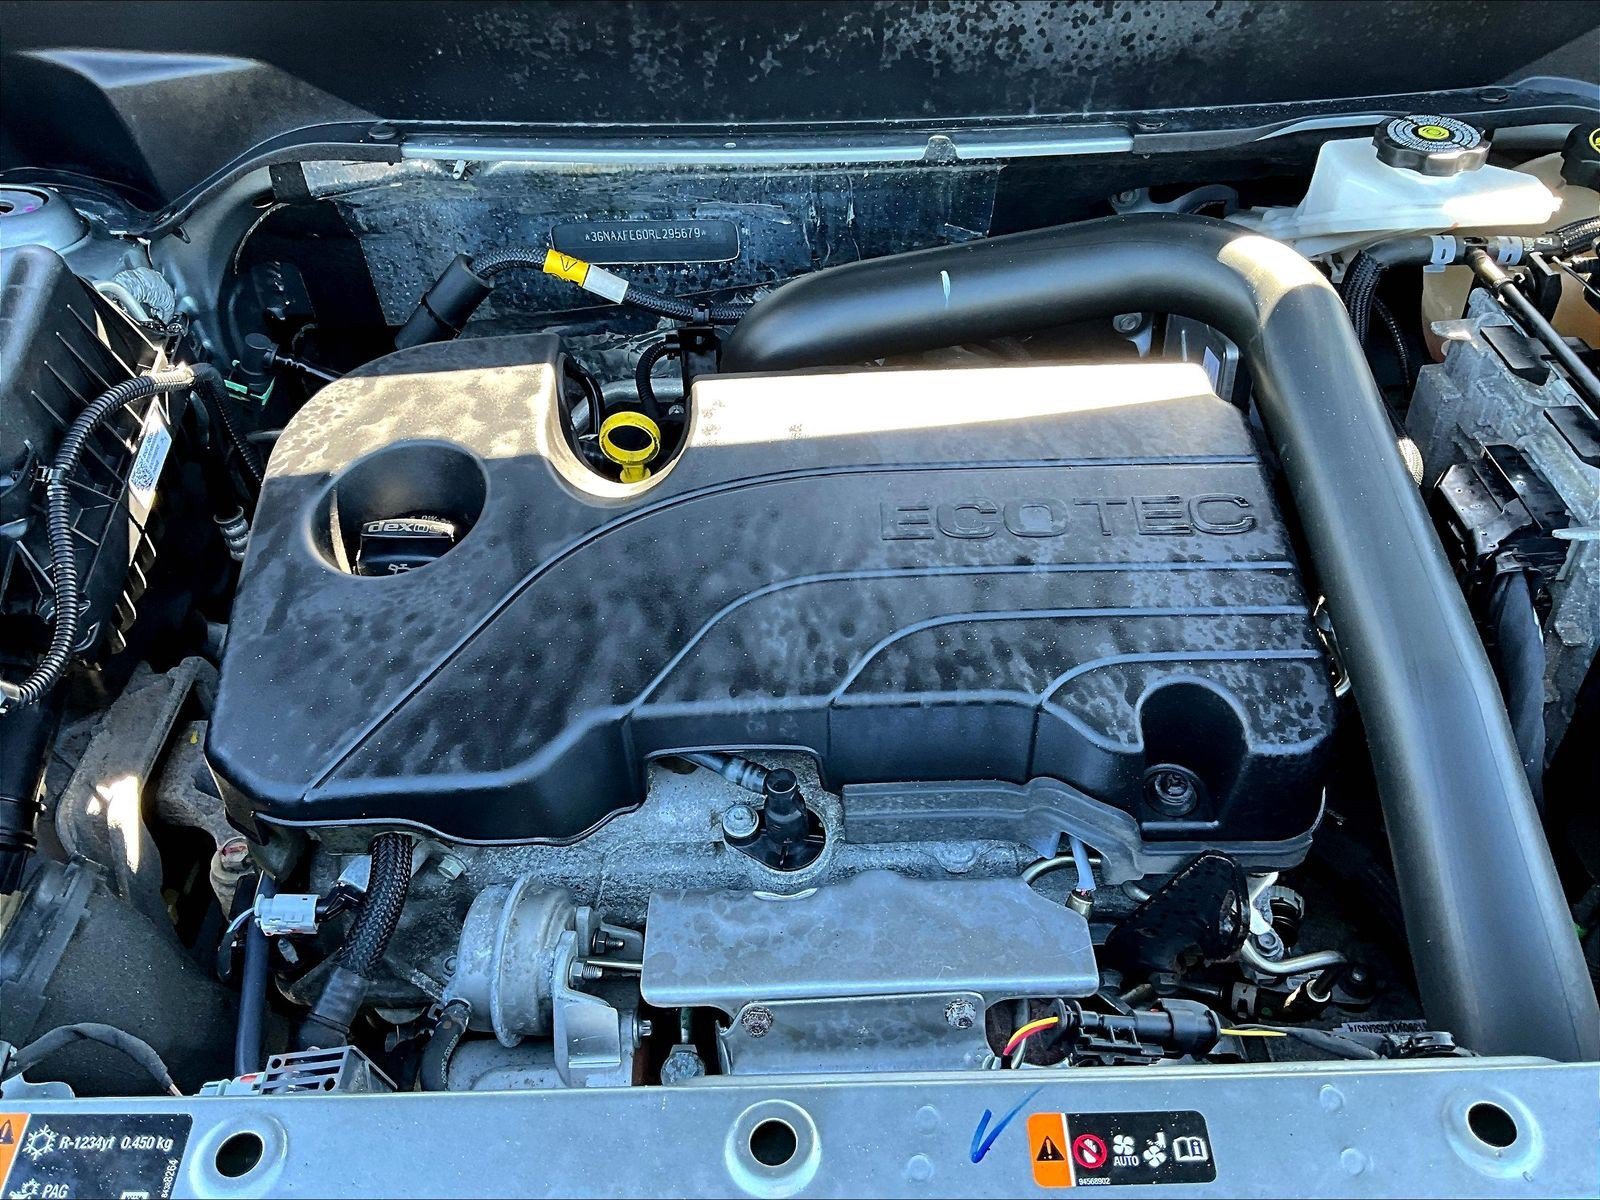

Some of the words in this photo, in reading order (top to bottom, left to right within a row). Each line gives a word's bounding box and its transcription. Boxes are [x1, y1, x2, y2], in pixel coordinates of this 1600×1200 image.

[879, 493, 1256, 540] ECOTEC
[368, 520, 446, 533] dexos
[59, 1136, 116, 1152] R-1234yf
[120, 1136, 155, 1149] 0.450
[156, 1136, 174, 1151] kg
[1113, 1155, 1140, 1167] AUTO
[42, 1184, 70, 1199] PAG
